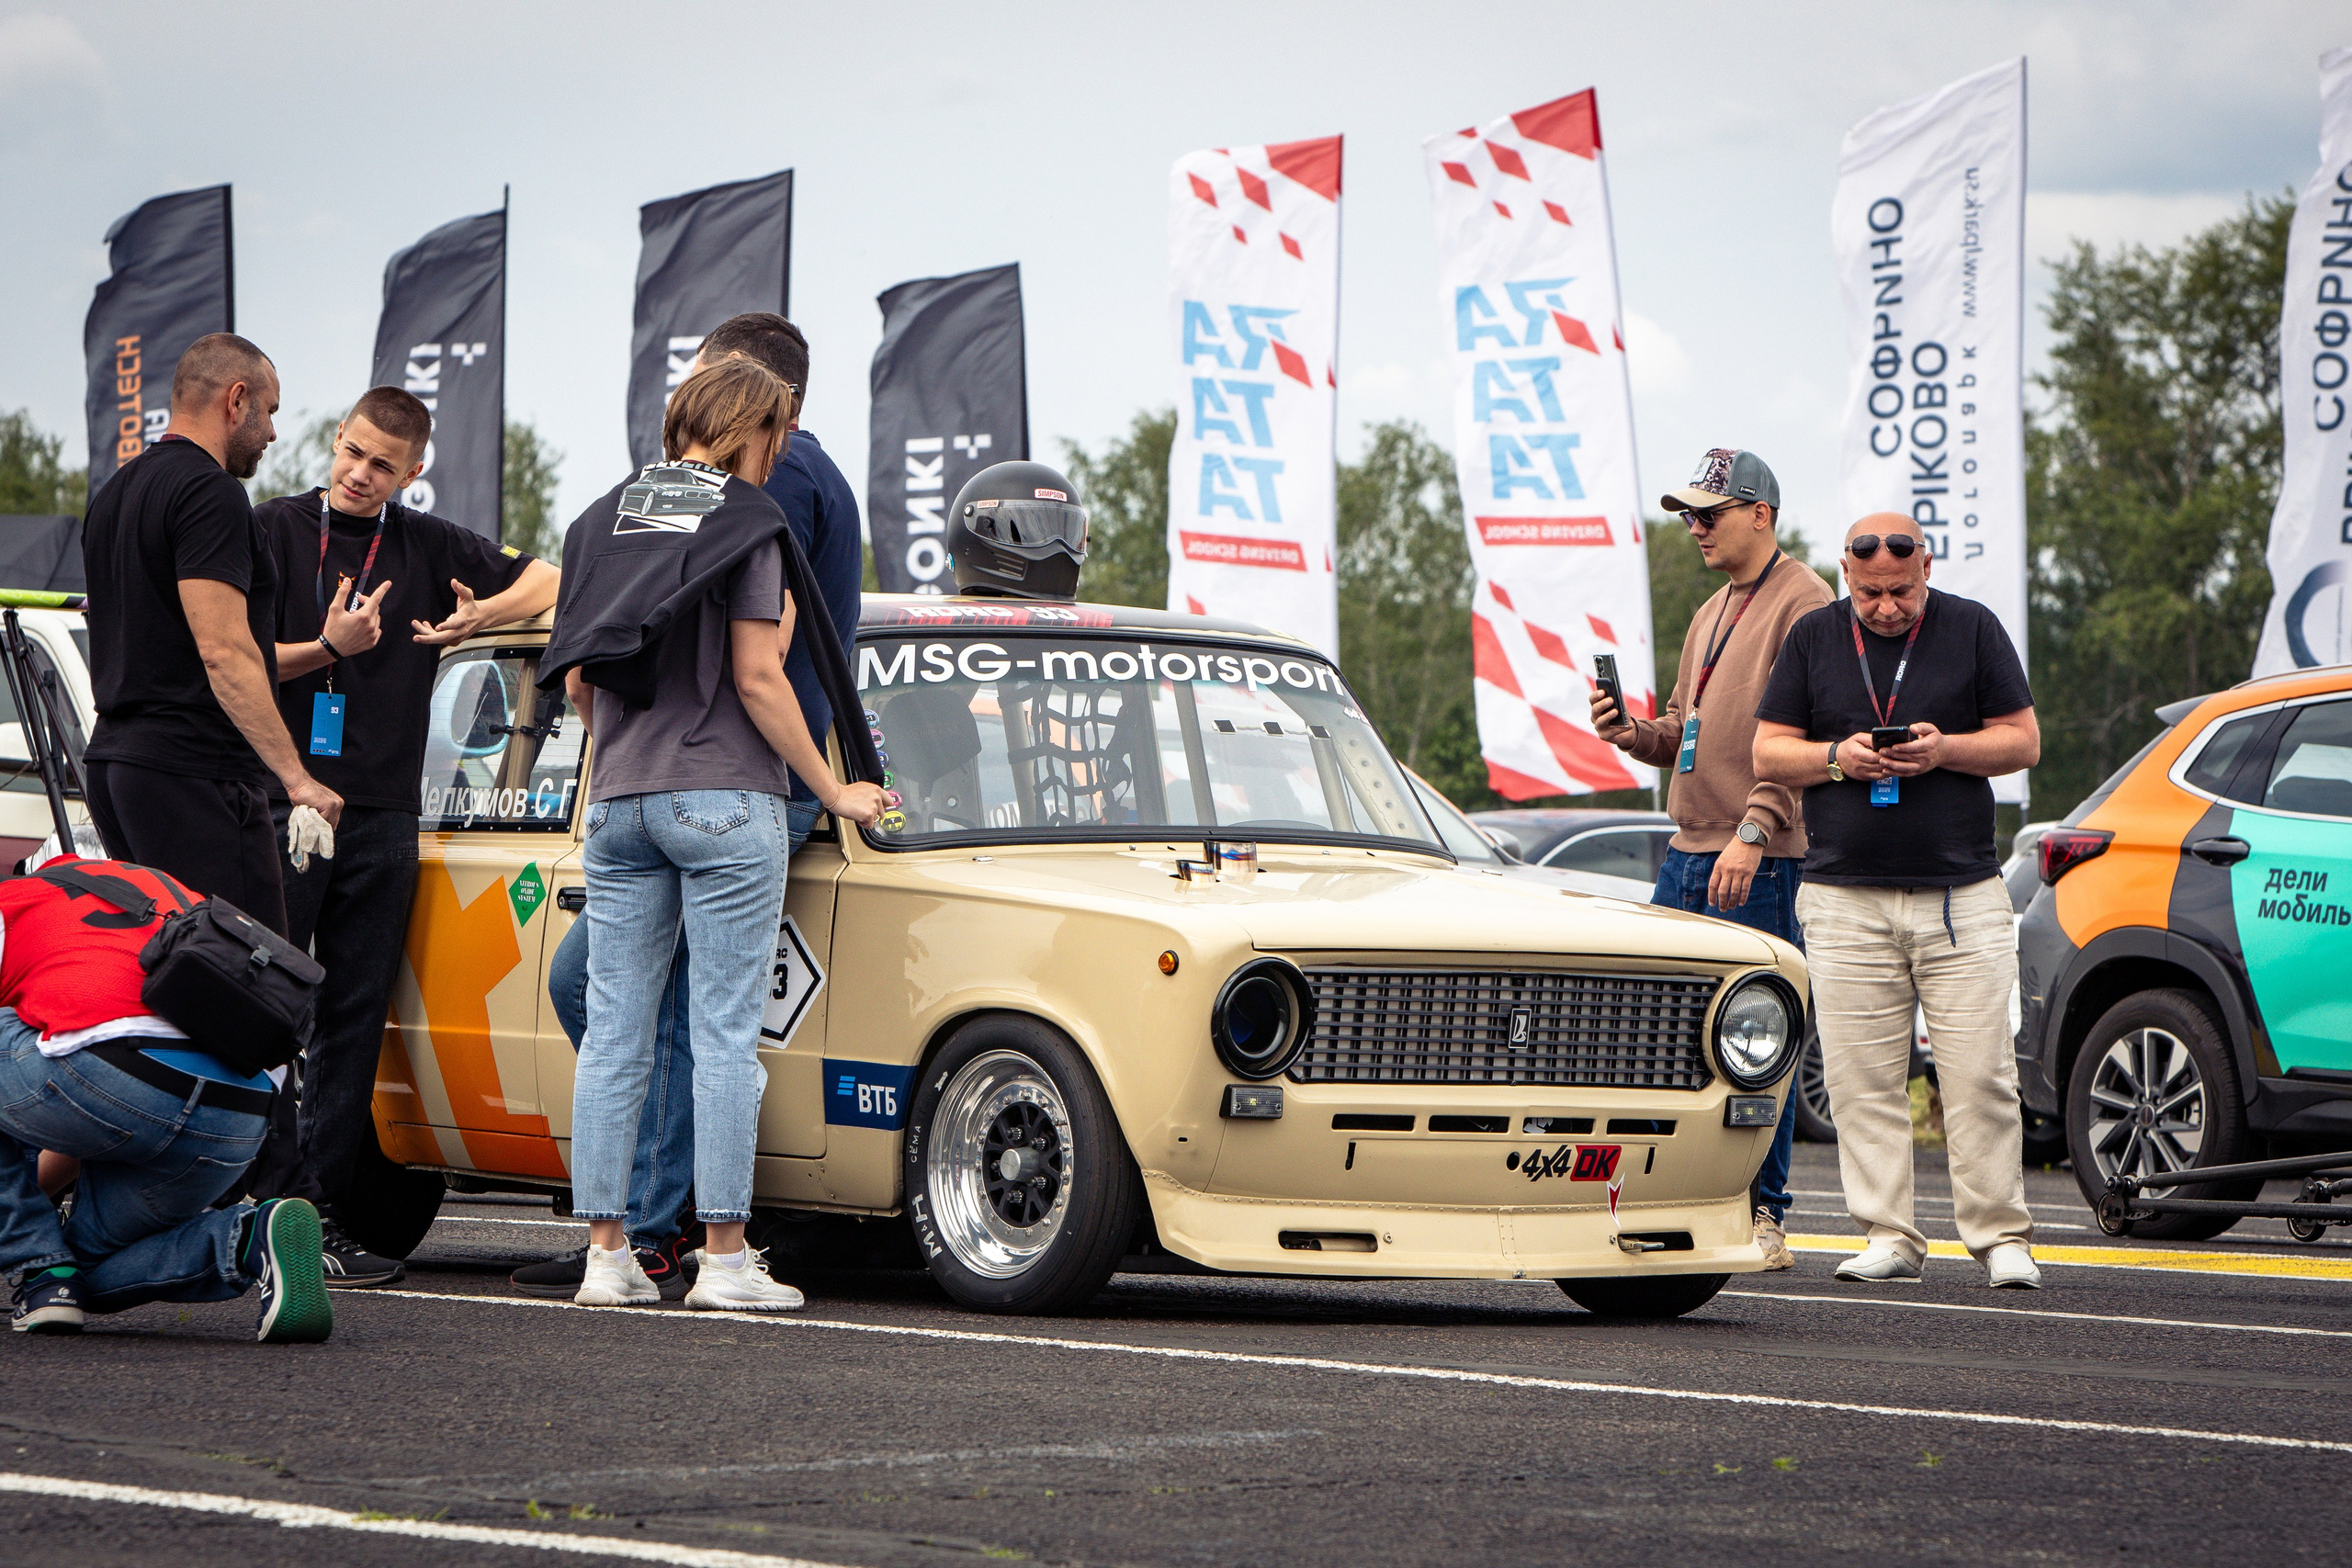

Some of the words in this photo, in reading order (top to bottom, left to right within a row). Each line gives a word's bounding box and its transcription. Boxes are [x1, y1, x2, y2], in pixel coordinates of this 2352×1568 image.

[1037, 490, 1065, 499] SIMPSON
[1024, 606, 1080, 621] 93
[557, 778, 577, 818] Г
[2264, 868, 2328, 894] дели
[2257, 893, 2352, 926] мобиль
[775, 948, 787, 958] RC
[769, 964, 788, 999] 3
[858, 1084, 898, 1116] ВТБ
